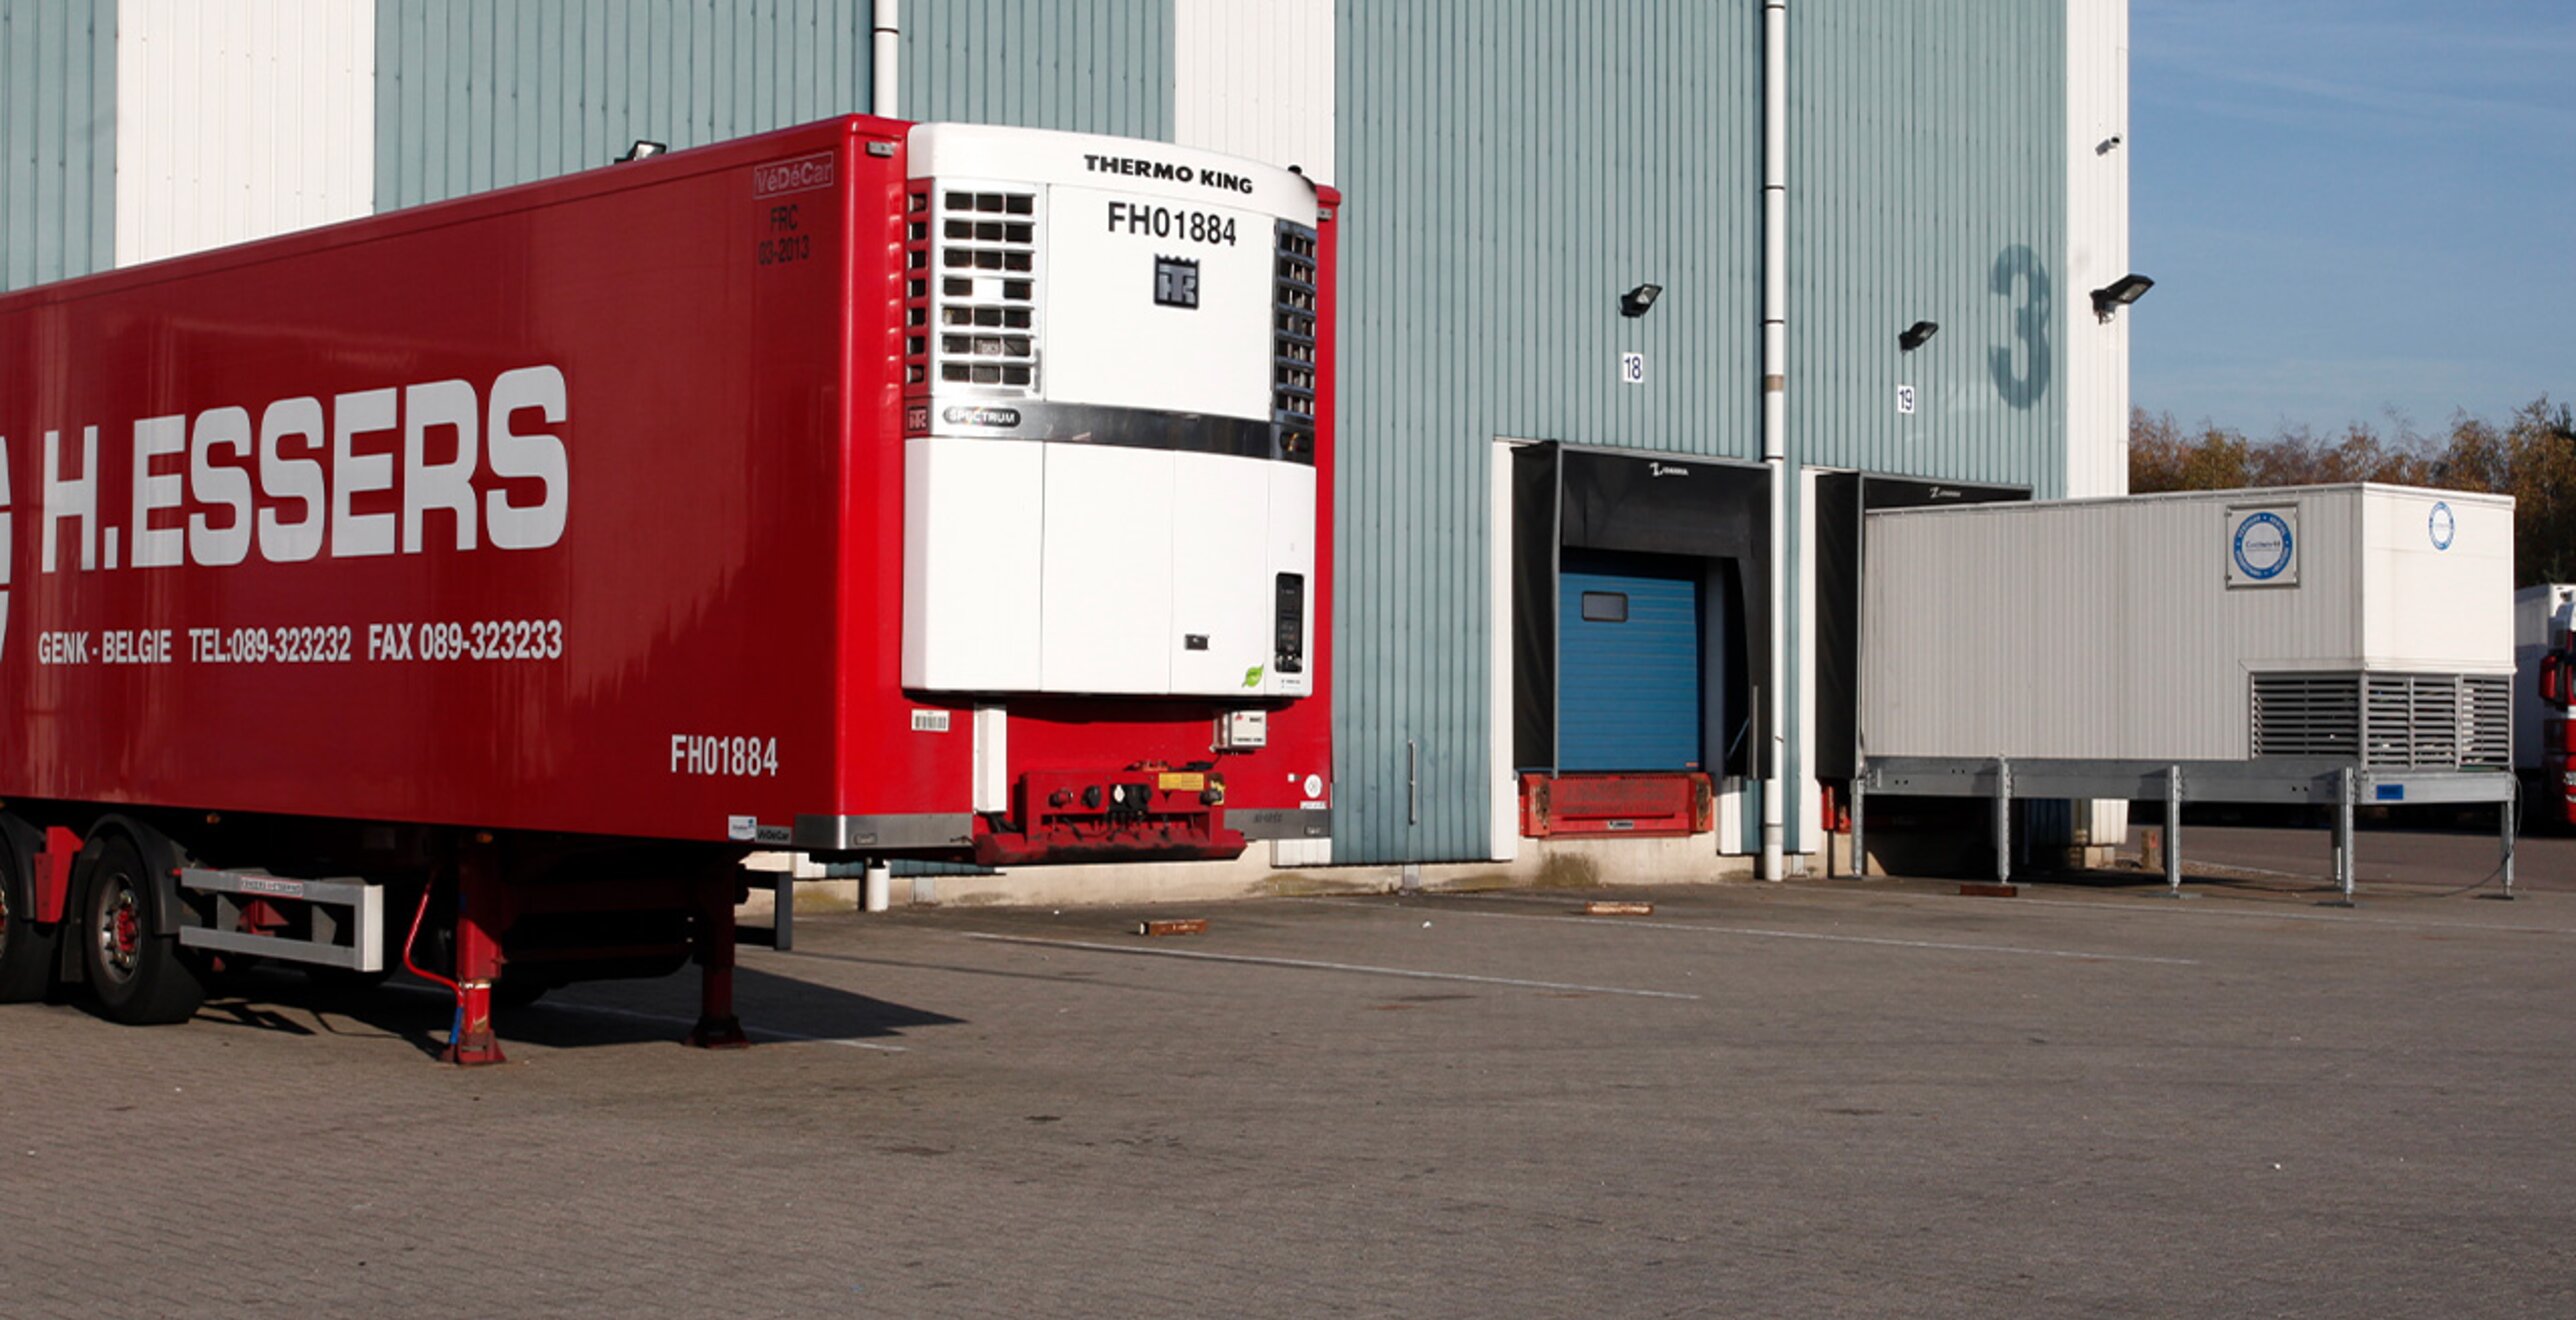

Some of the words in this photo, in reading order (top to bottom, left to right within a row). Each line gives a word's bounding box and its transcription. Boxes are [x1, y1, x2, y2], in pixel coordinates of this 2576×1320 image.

[1084, 154, 1194, 183] THERMO
[1200, 169, 1253, 194] KING
[770, 204, 798, 231] FRC
[1108, 201, 1236, 246] FH01884
[1989, 244, 2051, 410] 3
[1624, 356, 1641, 380] 18
[1899, 389, 1912, 411] 19
[42, 365, 568, 573] H.ESSERS
[38, 632, 89, 664] GENK
[102, 630, 171, 663] BELGIE
[189, 627, 351, 663] TEL:089-323232
[368, 623, 413, 661] FAX
[419, 619, 562, 661] 089-323233
[671, 734, 778, 776] FH01884
